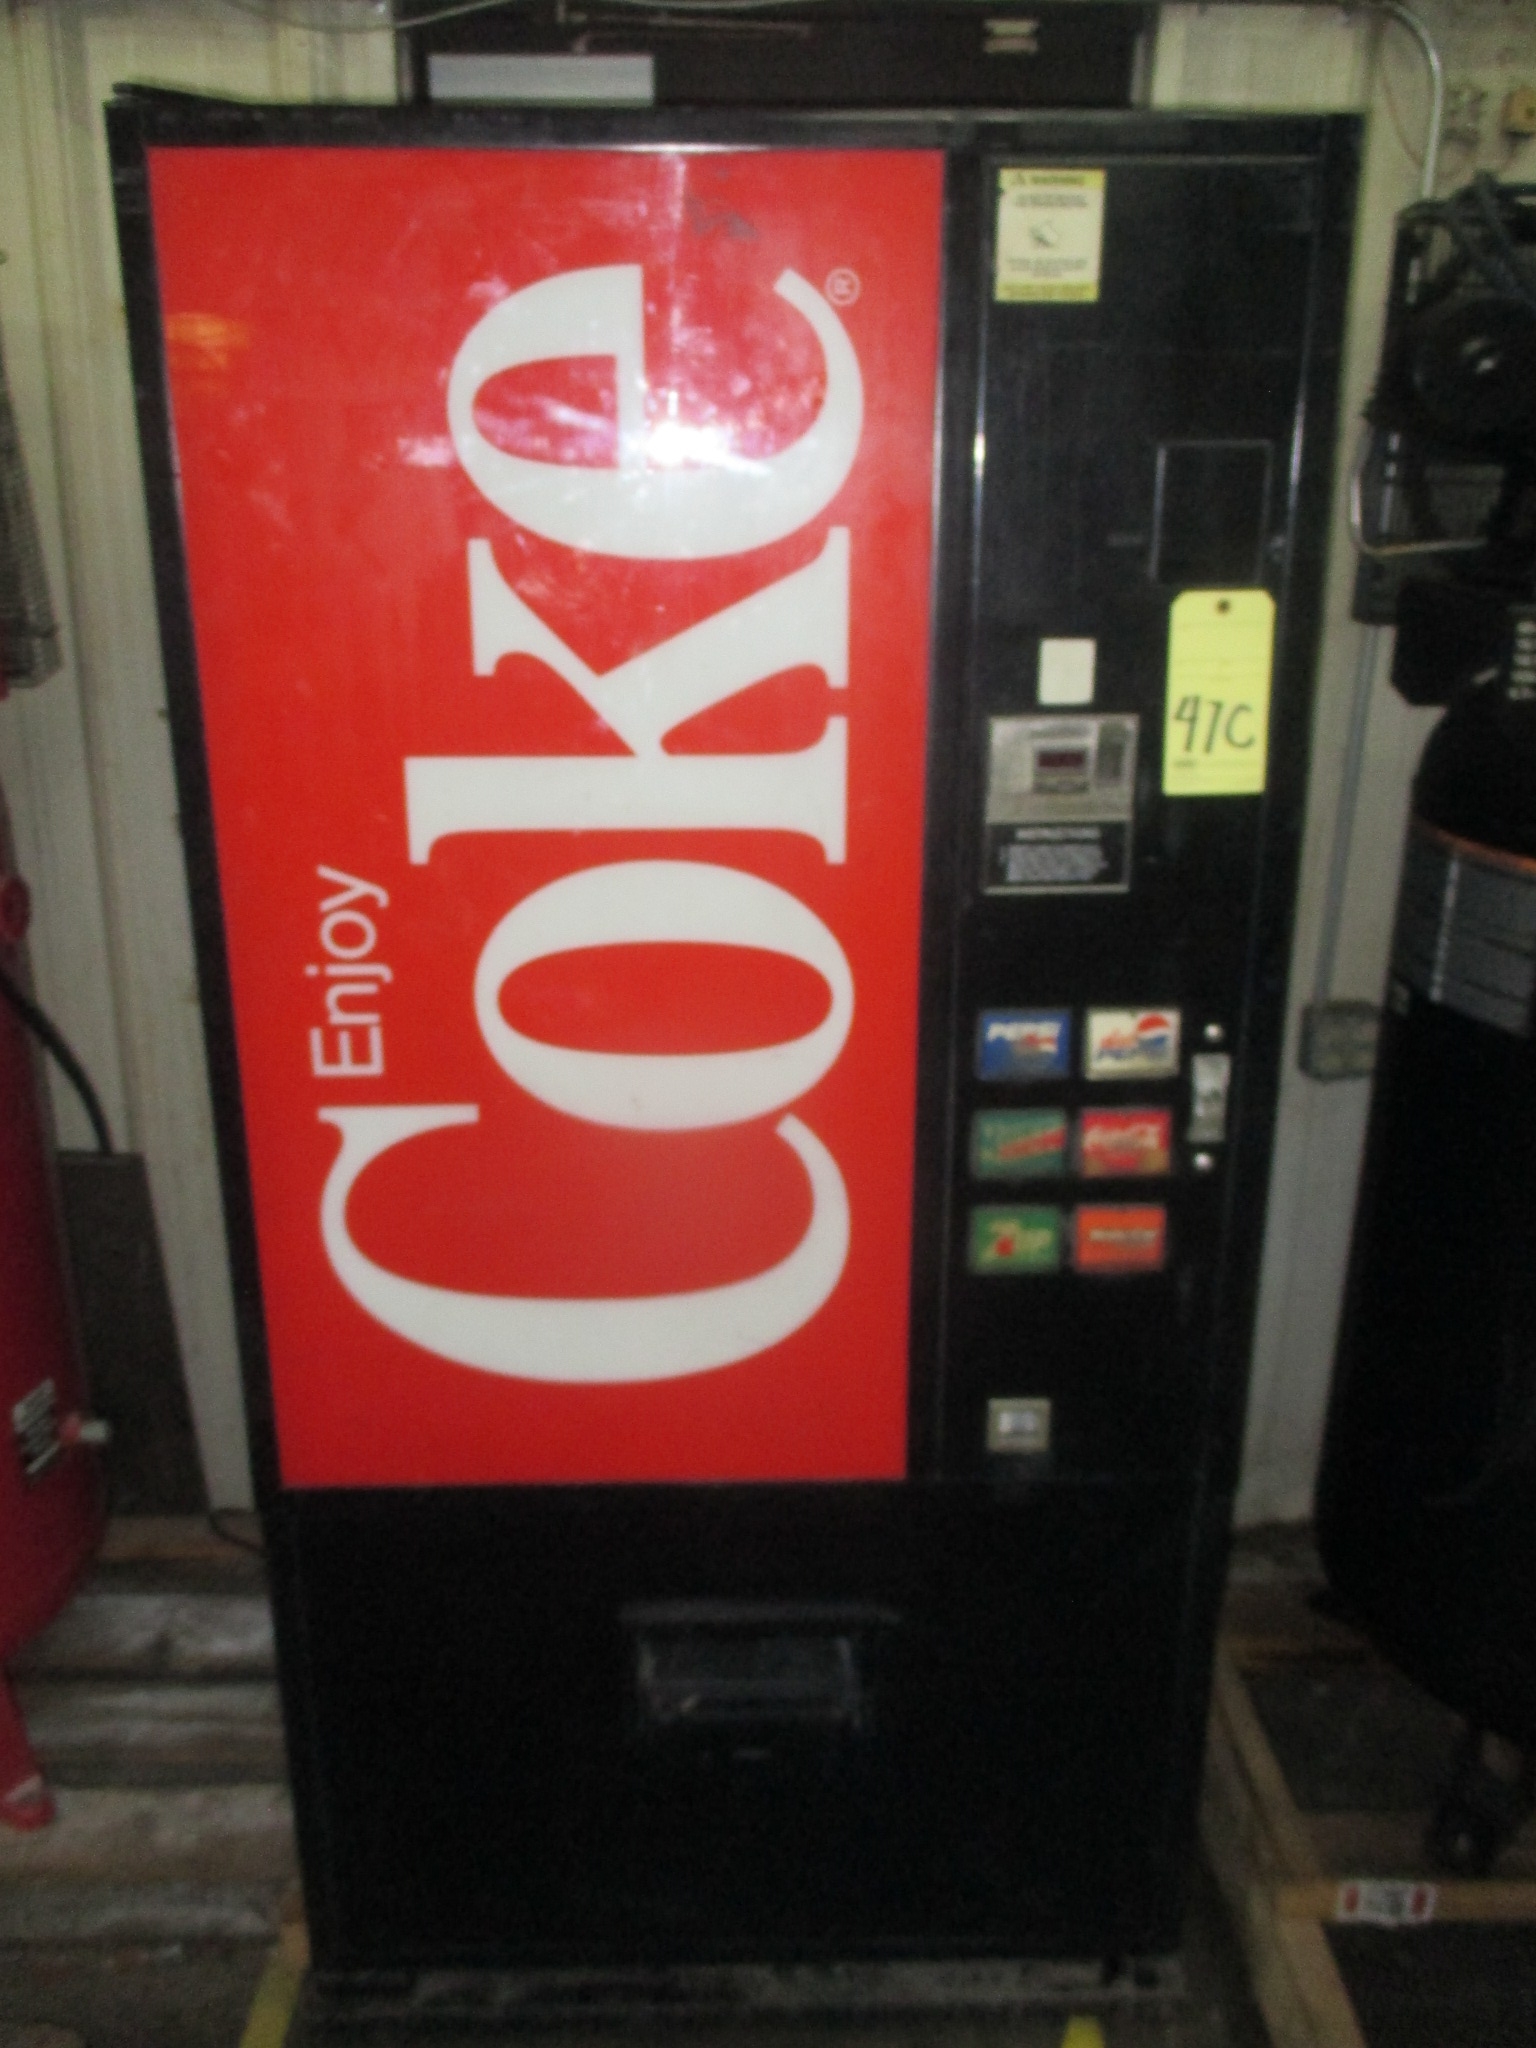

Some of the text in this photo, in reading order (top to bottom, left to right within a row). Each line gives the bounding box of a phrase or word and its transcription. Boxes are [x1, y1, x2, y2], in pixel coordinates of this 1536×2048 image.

[318, 263, 866, 1383] Coke
[1172, 692, 1256, 755] 47C
[304, 865, 392, 1078] Enjoy
